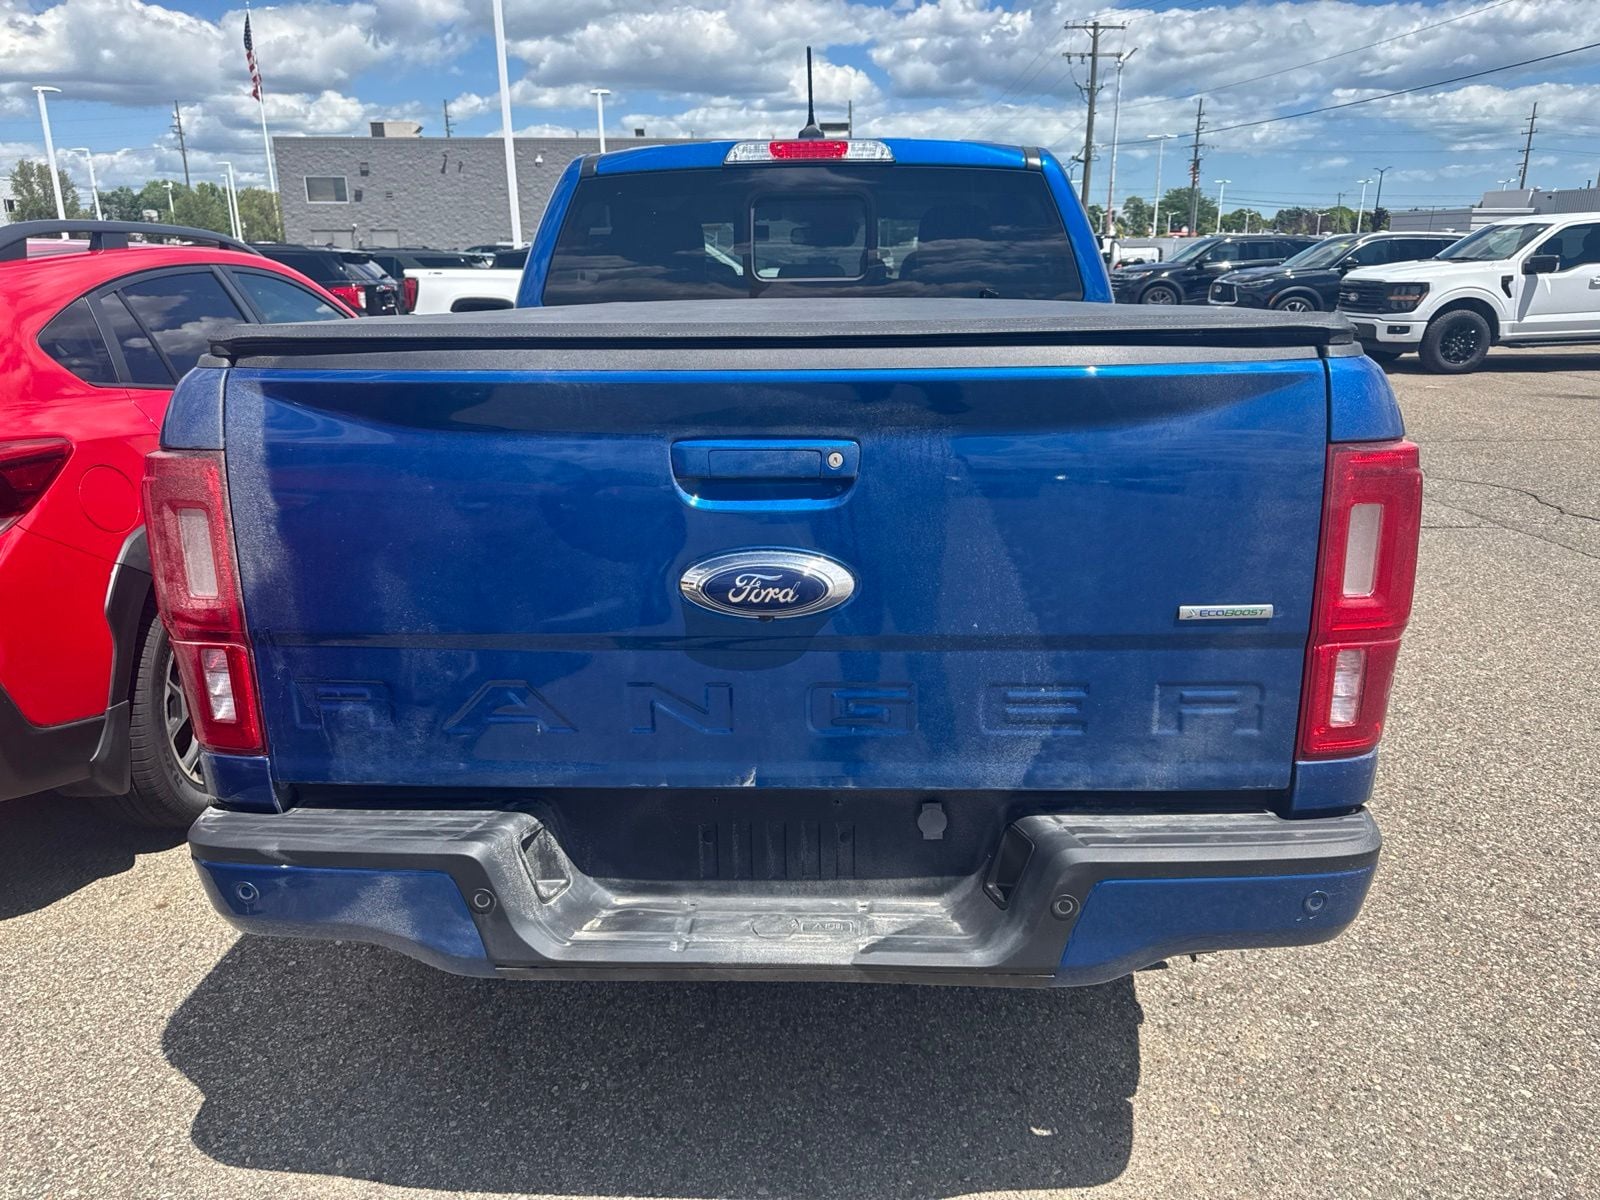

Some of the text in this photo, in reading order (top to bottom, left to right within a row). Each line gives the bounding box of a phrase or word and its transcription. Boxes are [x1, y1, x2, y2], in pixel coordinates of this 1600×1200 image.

[728, 573, 802, 604] Ford
[1199, 608, 1267, 618] ECOBOOST
[292, 679, 1266, 735] RANGER
